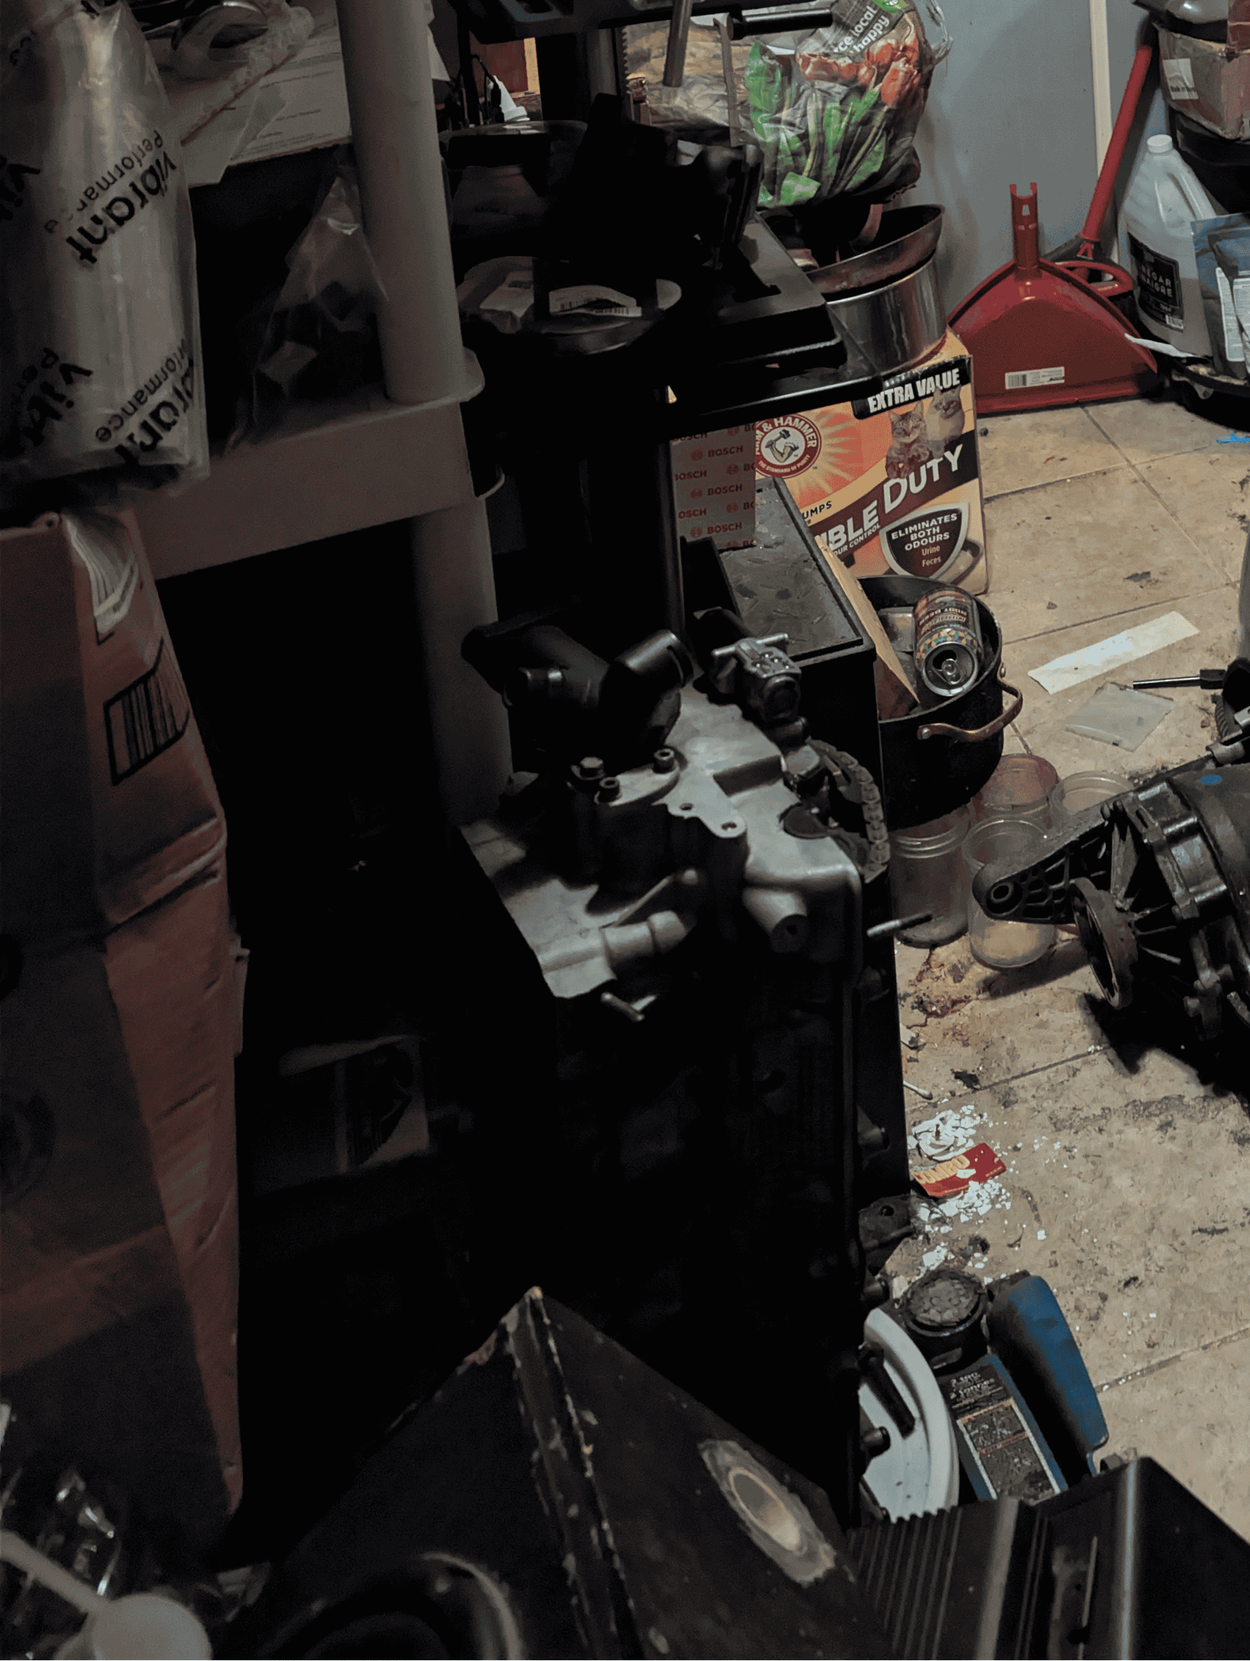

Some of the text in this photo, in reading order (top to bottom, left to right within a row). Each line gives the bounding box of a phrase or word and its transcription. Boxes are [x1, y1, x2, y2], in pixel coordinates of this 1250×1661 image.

[853, 4, 879, 39] local
[853, 13, 891, 55] happy
[867, 383, 915, 414] EXTRA
[915, 367, 961, 397] VALUE
[773, 416, 817, 448] HAMMER
[707, 445, 744, 458] BOSCH
[707, 484, 743, 496] BOSCH
[883, 444, 964, 515] DUTY
[707, 522, 742, 535] BOSCH
[849, 523, 881, 549] CONTROL
[891, 513, 958, 540] ELIMINATES
[910, 526, 940, 541] BOTH
[904, 531, 950, 551] ODOURS
[921, 545, 941, 557] Urine
[922, 556, 942, 568] Feces
